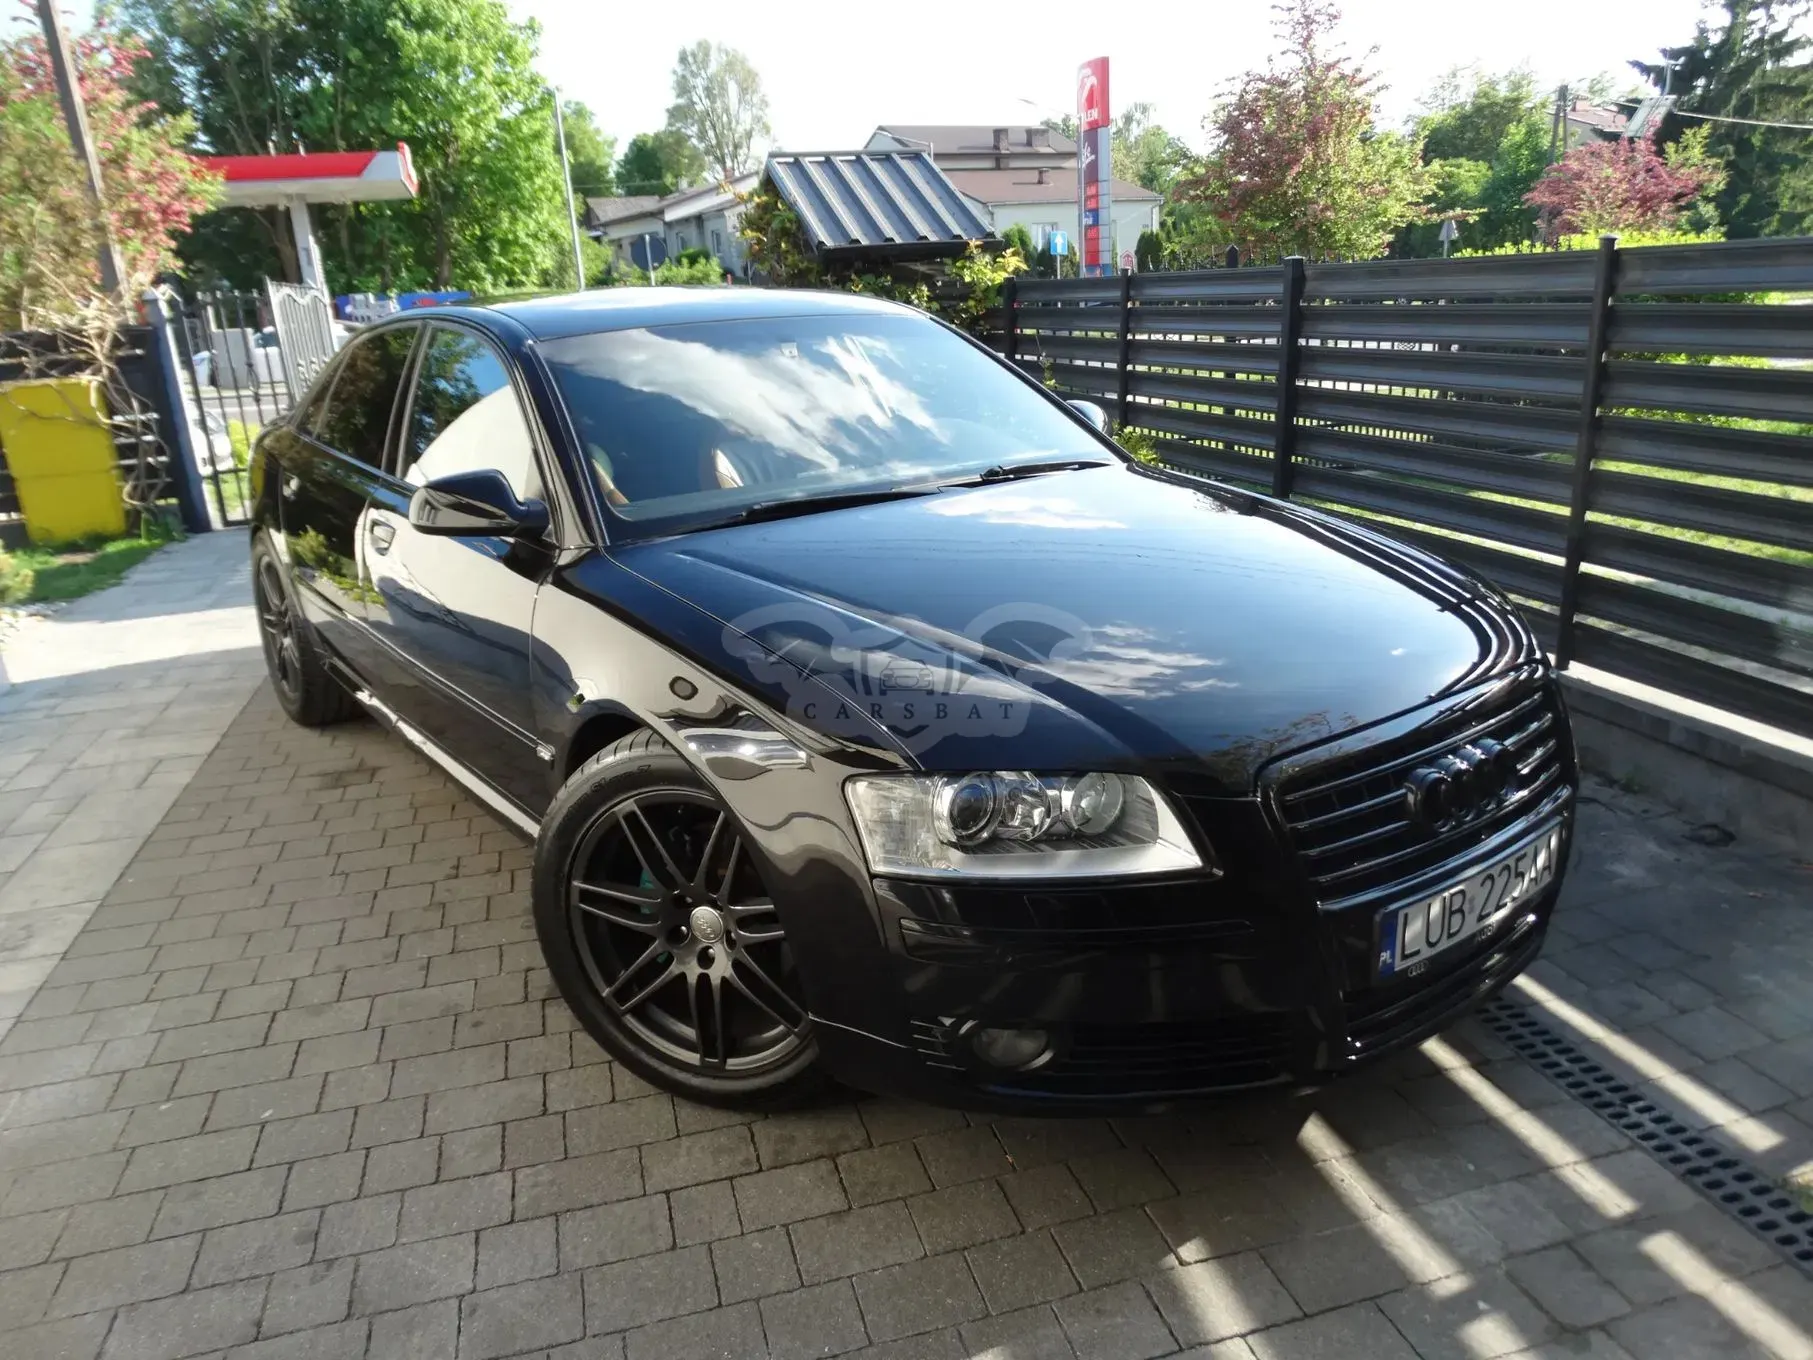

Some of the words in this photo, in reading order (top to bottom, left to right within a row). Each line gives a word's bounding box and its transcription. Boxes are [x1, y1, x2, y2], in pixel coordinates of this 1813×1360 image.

[1080, 108, 1098, 121] LEN
[1400, 888, 1466, 961] LUB
[1379, 950, 1392, 966] PL
